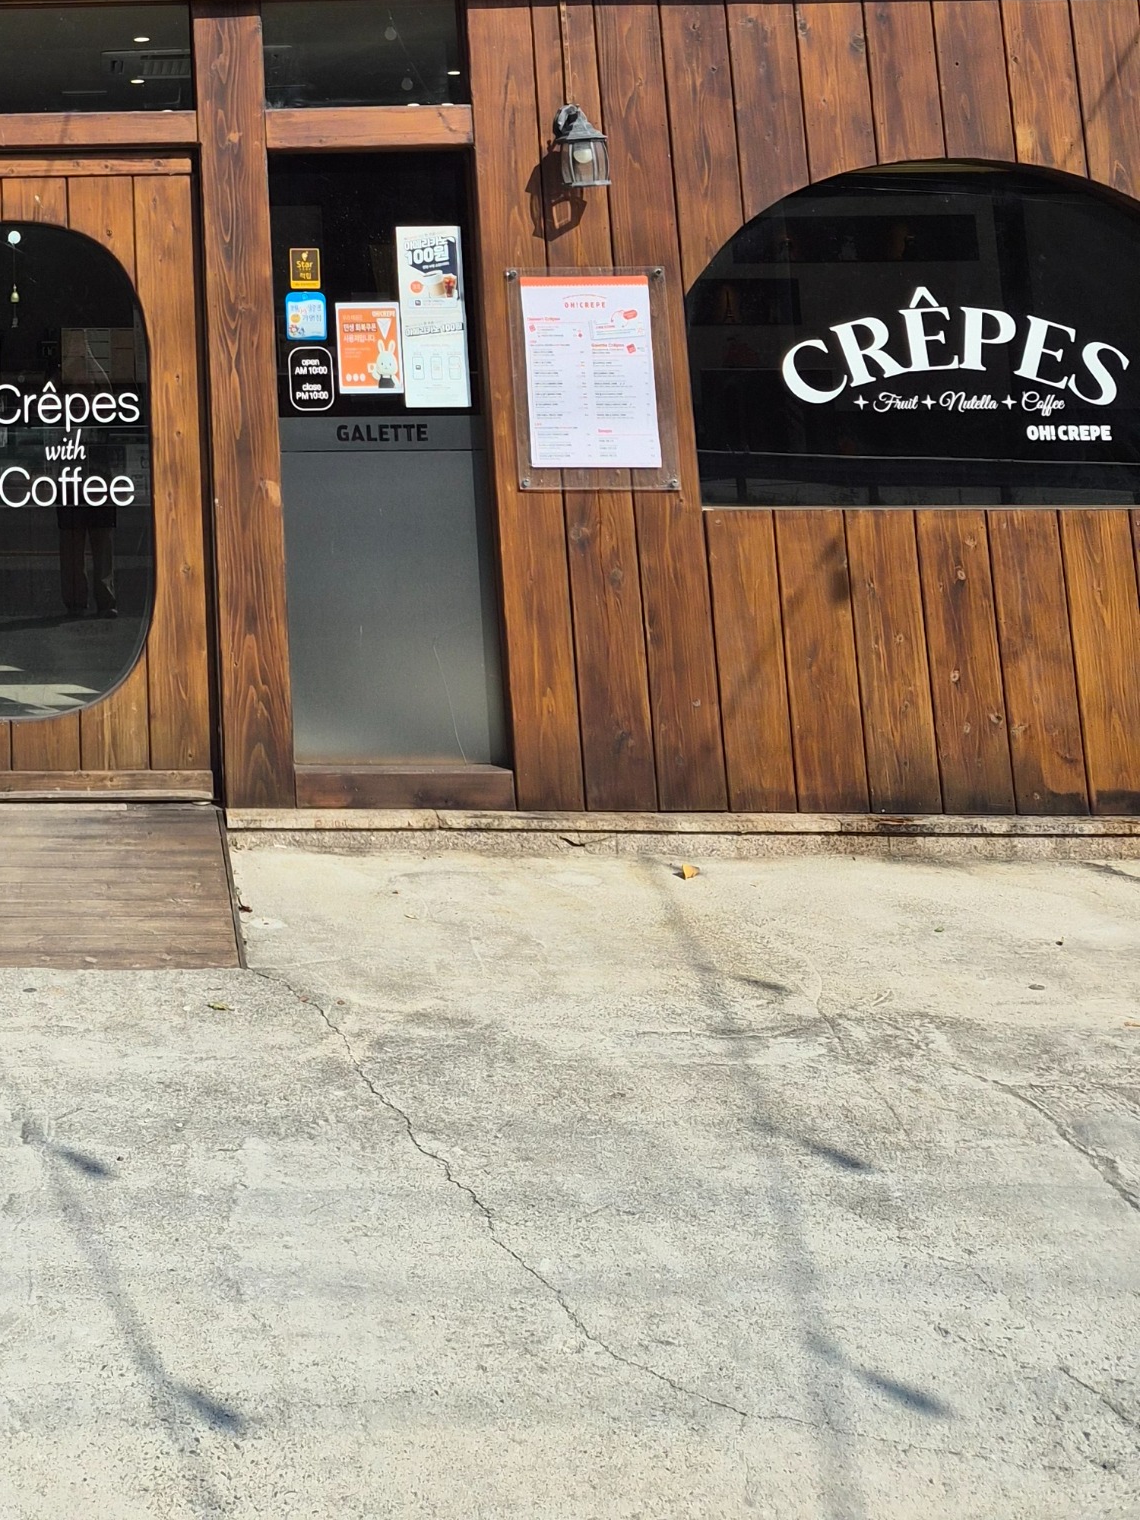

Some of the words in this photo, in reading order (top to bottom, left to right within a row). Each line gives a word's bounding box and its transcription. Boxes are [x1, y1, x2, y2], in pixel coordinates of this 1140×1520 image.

[405, 245, 449, 265] 100원
[782, 286, 1130, 406] CRÊPES
[295, 366, 307, 375] AM
[308, 366, 328, 375] 10:00
[301, 359, 320, 367] open
[302, 383, 322, 391] close
[309, 391, 329, 400] 10:00
[873, 391, 918, 413] Fruit
[939, 391, 999, 412] Nutella
[1021, 391, 1066, 417] Coffee
[336, 424, 429, 442] GALETTE
[45, 430, 87, 461] with
